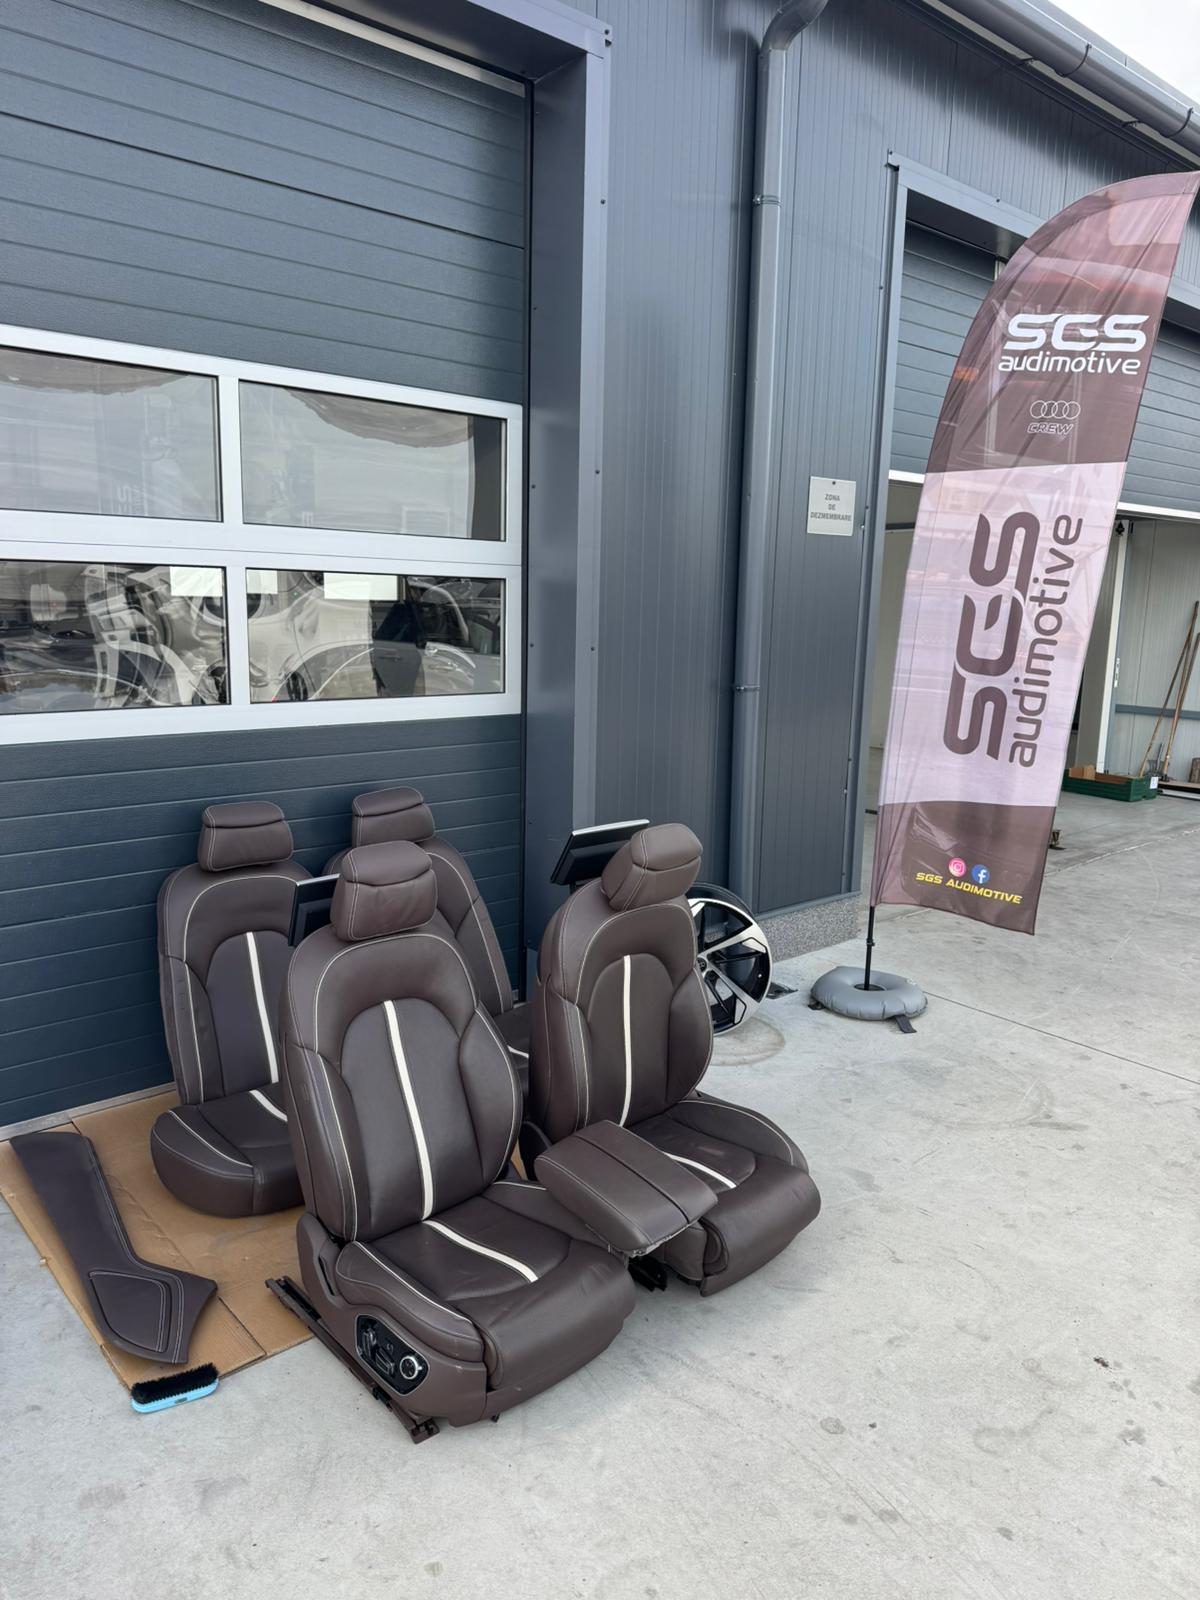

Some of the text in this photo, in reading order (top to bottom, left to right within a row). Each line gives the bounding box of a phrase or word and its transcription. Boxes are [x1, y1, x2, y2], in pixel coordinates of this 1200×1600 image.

[1003, 313, 1150, 352] SGS
[998, 351, 1142, 375] audimotive
[1027, 422, 1074, 435] CREW
[810, 511, 852, 521] DEZMEMBRARE
[943, 511, 1041, 761] SGS
[1008, 514, 1083, 768] audimotive
[916, 872, 1022, 904] SGS AUDIMOTIVE
